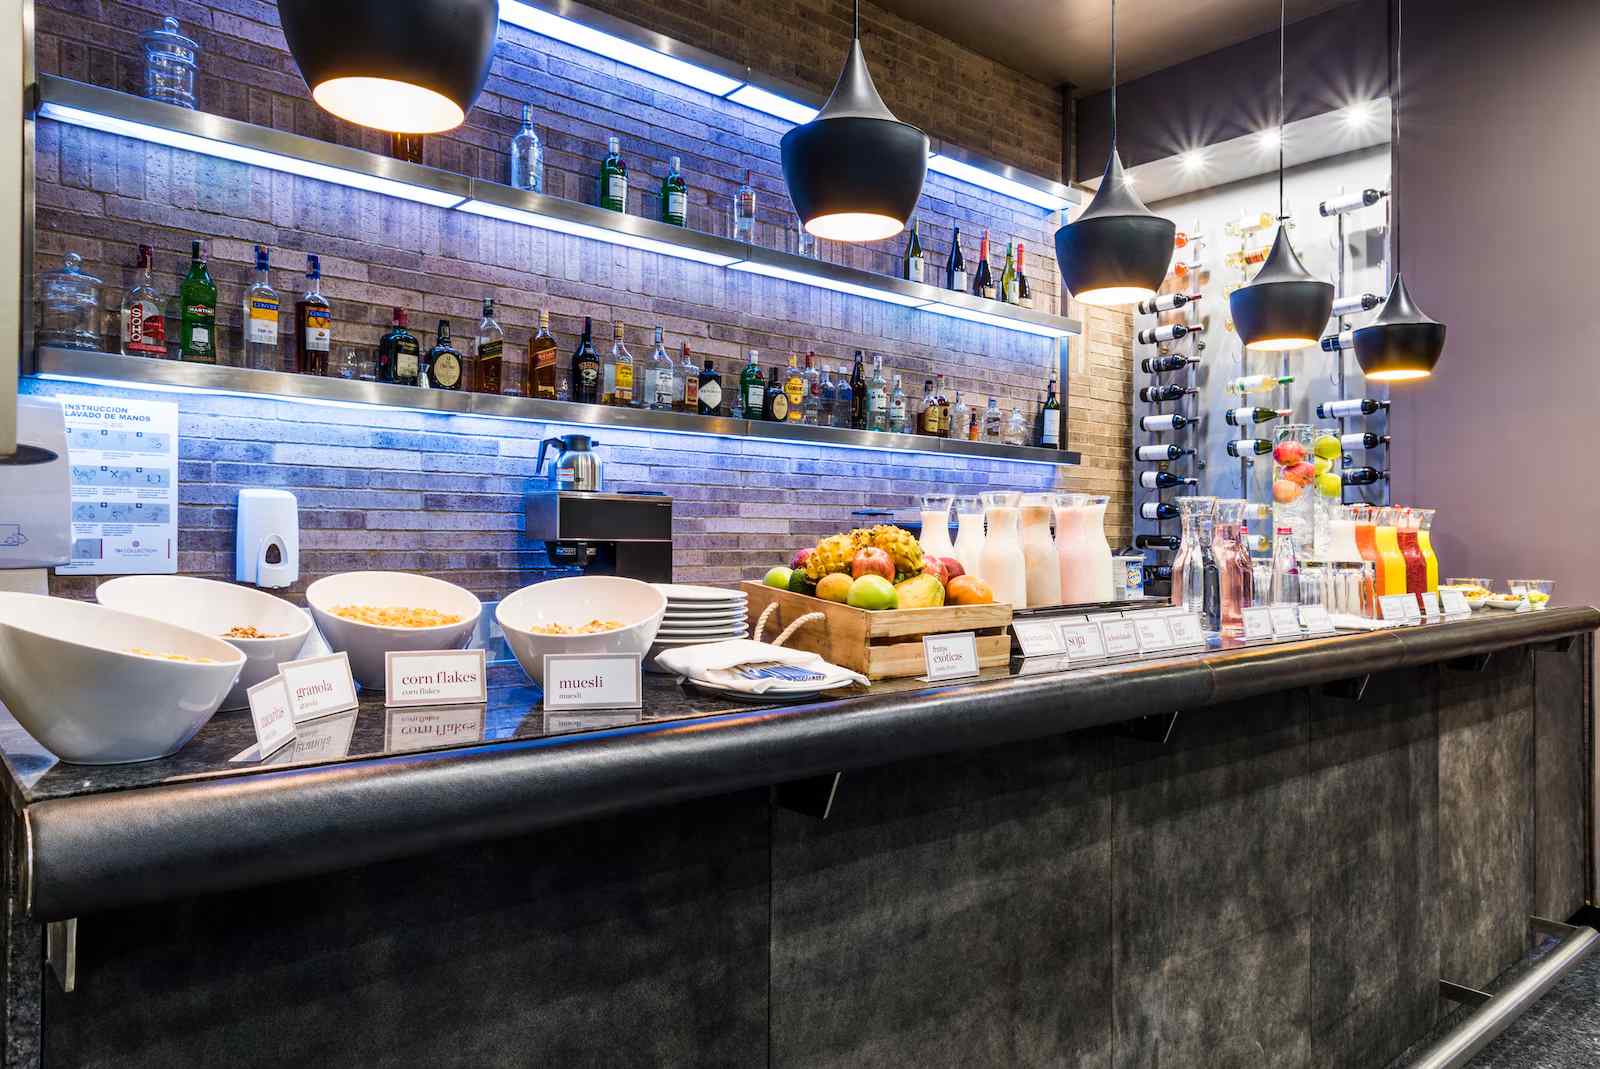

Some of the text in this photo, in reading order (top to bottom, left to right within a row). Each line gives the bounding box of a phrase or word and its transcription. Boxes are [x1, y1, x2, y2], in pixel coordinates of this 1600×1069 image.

[64, 403, 129, 413] INSTRUCCION
[64, 410, 151, 422] LAVADO DE MANOS
[402, 671, 478, 685] corn flakes
[559, 674, 604, 689] muesli
[295, 679, 333, 699] granola
